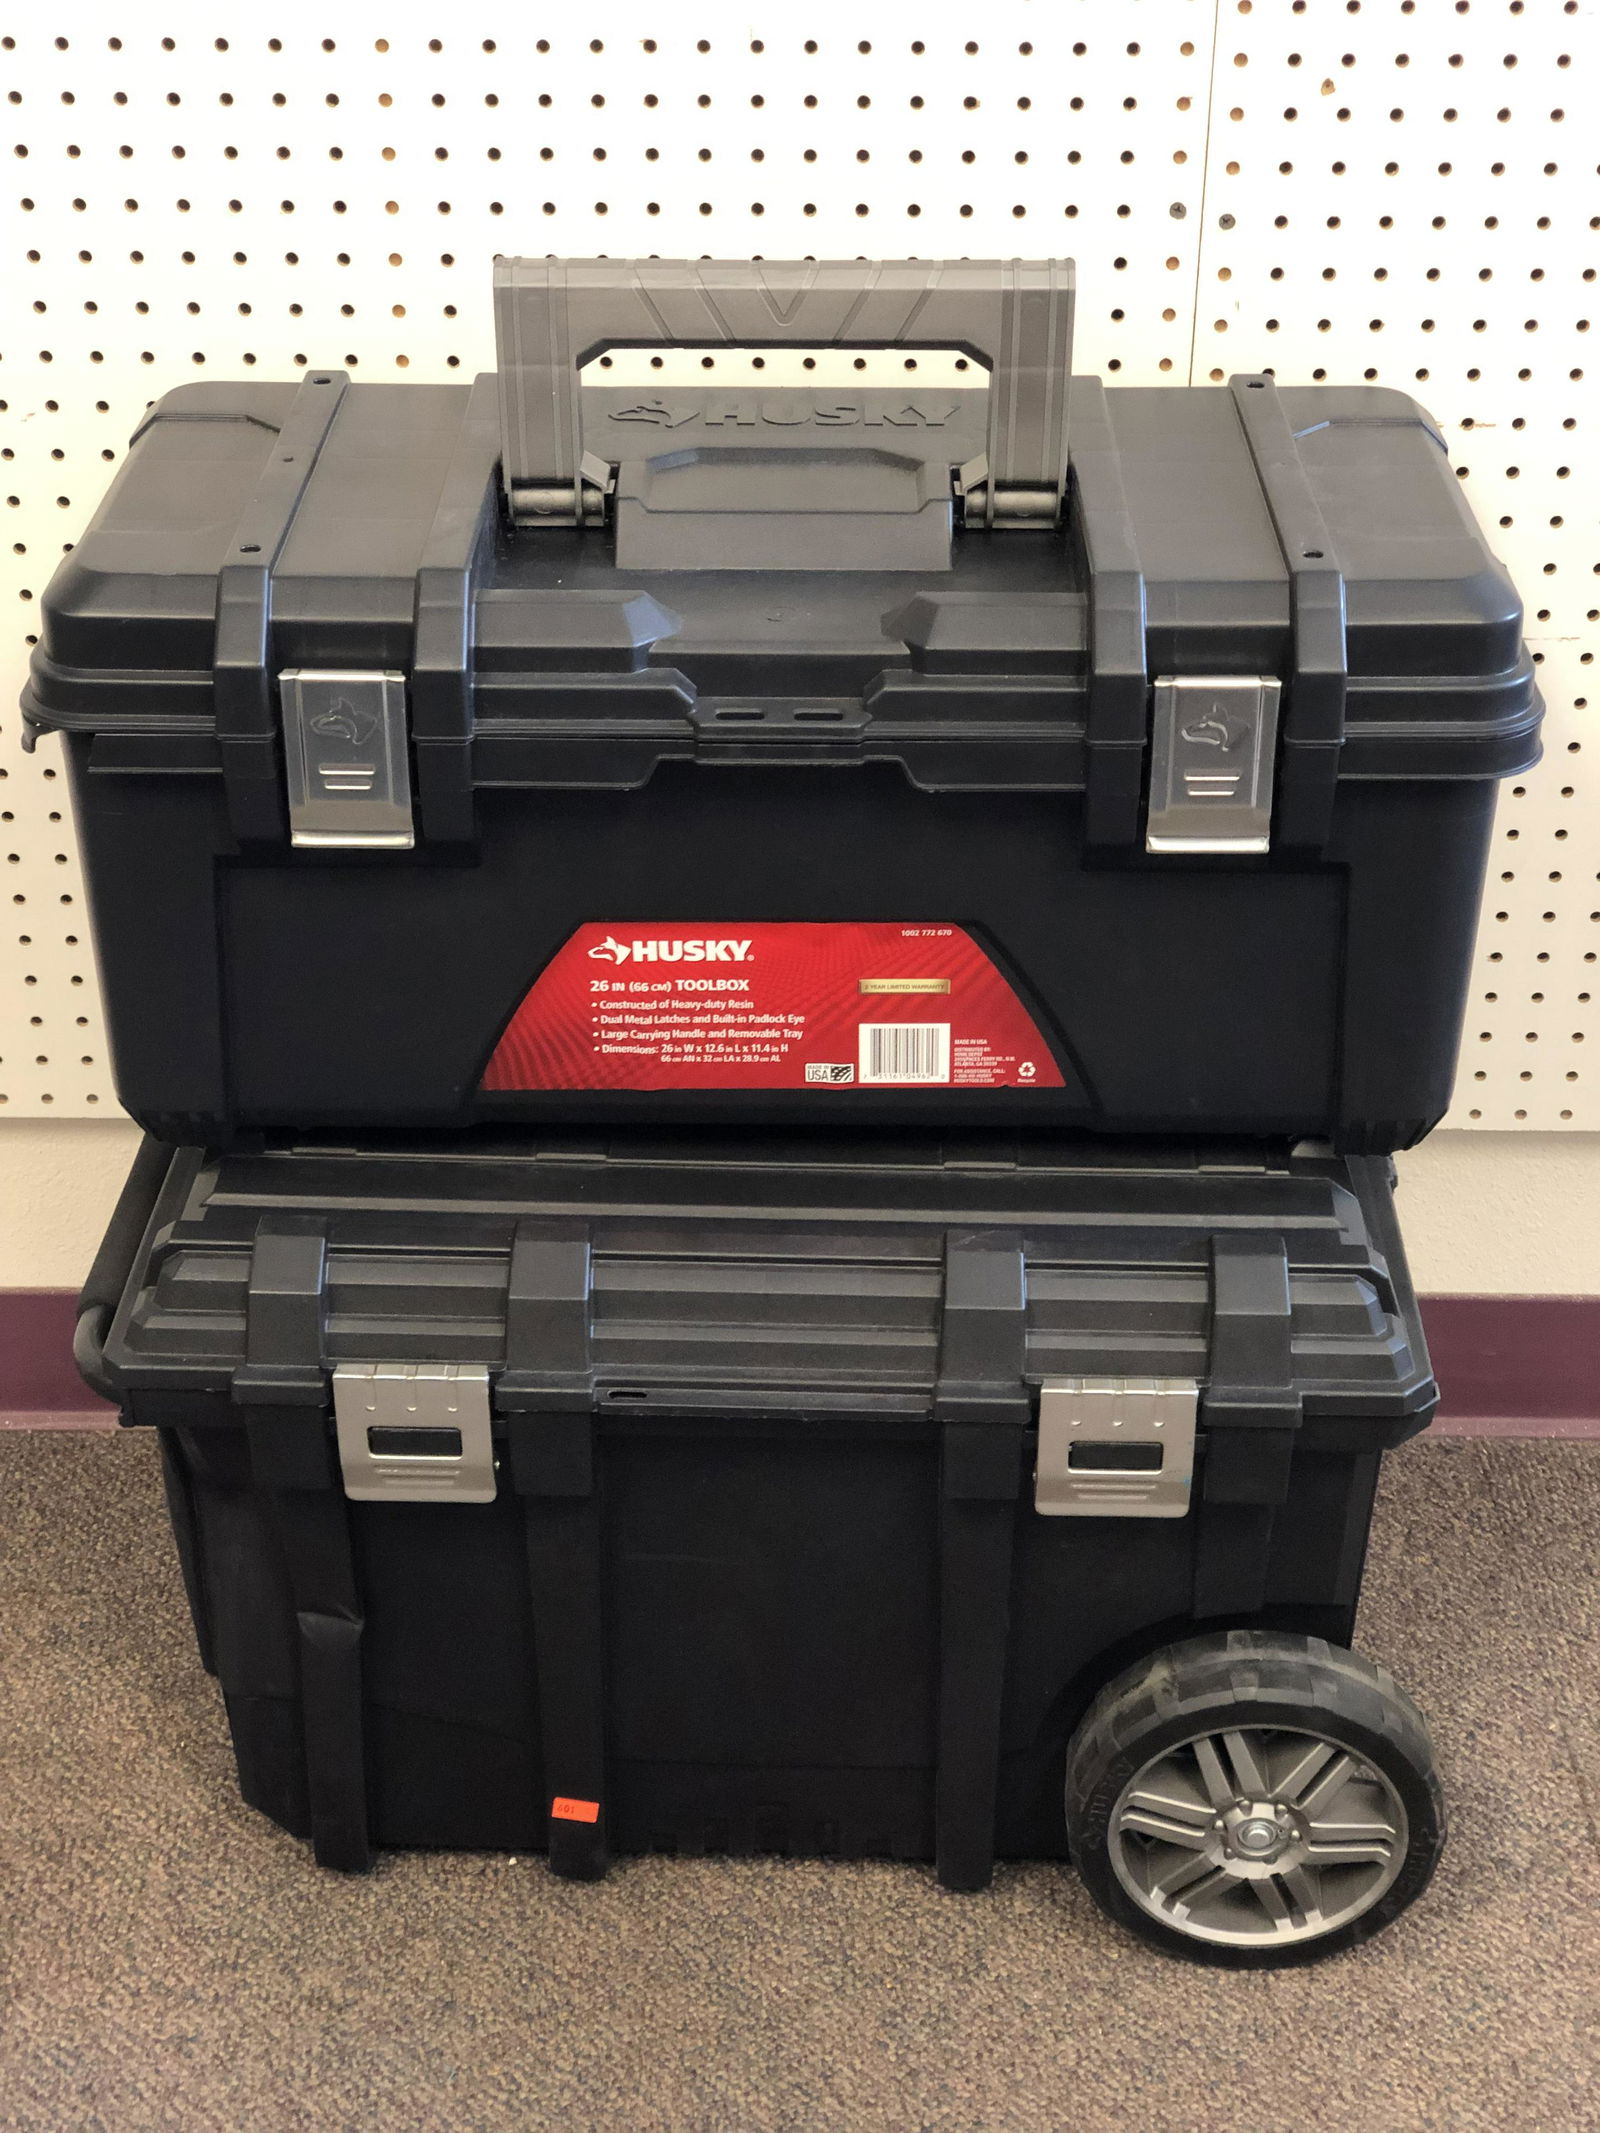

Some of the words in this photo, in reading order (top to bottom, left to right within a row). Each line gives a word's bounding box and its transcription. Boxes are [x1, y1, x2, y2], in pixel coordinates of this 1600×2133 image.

[705, 402, 962, 428] HUSKY
[632, 940, 754, 962] HUSKY
[590, 980, 609, 992] 26
[612, 982, 625, 992] IN
[629, 981, 649, 992] (66
[675, 979, 749, 991] TOOLBOX
[600, 999, 657, 1010] Constructed
[659, 999, 670, 1010] of
[671, 999, 726, 1010] Heavy-duty
[728, 999, 754, 1010] Resin
[600, 1014, 623, 1024] Dual
[625, 1014, 652, 1024] Metal
[654, 1014, 691, 1024] Latches
[692, 1014, 710, 1024] and
[712, 1014, 746, 1024] Built-in
[748, 1014, 785, 1024] Padlock
[788, 1014, 805, 1024] Eye
[601, 1029, 629, 1040] Large
[630, 1029, 671, 1040] Carrying
[672, 1029, 706, 1040] Handle
[708, 1029, 726, 1040] and
[728, 1029, 781, 1040] Removable
[783, 1029, 803, 1040] Tray
[602, 1045, 659, 1055] Dimensions:
[661, 1044, 673, 1053] 26
[674, 1044, 682, 1053] in
[683, 1044, 695, 1053] W
[696, 1044, 702, 1053] x
[706, 1044, 724, 1053] 12.6
[725, 1044, 733, 1053] in
[735, 1044, 741, 1053] L
[742, 1044, 748, 1053] x
[751, 1044, 770, 1053] 11.4
[771, 1044, 778, 1053] in
[780, 1044, 788, 1053] H
[661, 1055, 671, 1063] 66
[683, 1055, 695, 1063] AN
[703, 1055, 712, 1063] 32
[724, 1055, 734, 1063] LA
[742, 1055, 759, 1063] 28.9
[771, 1055, 781, 1063] AL
[808, 1070, 828, 1080] USA
